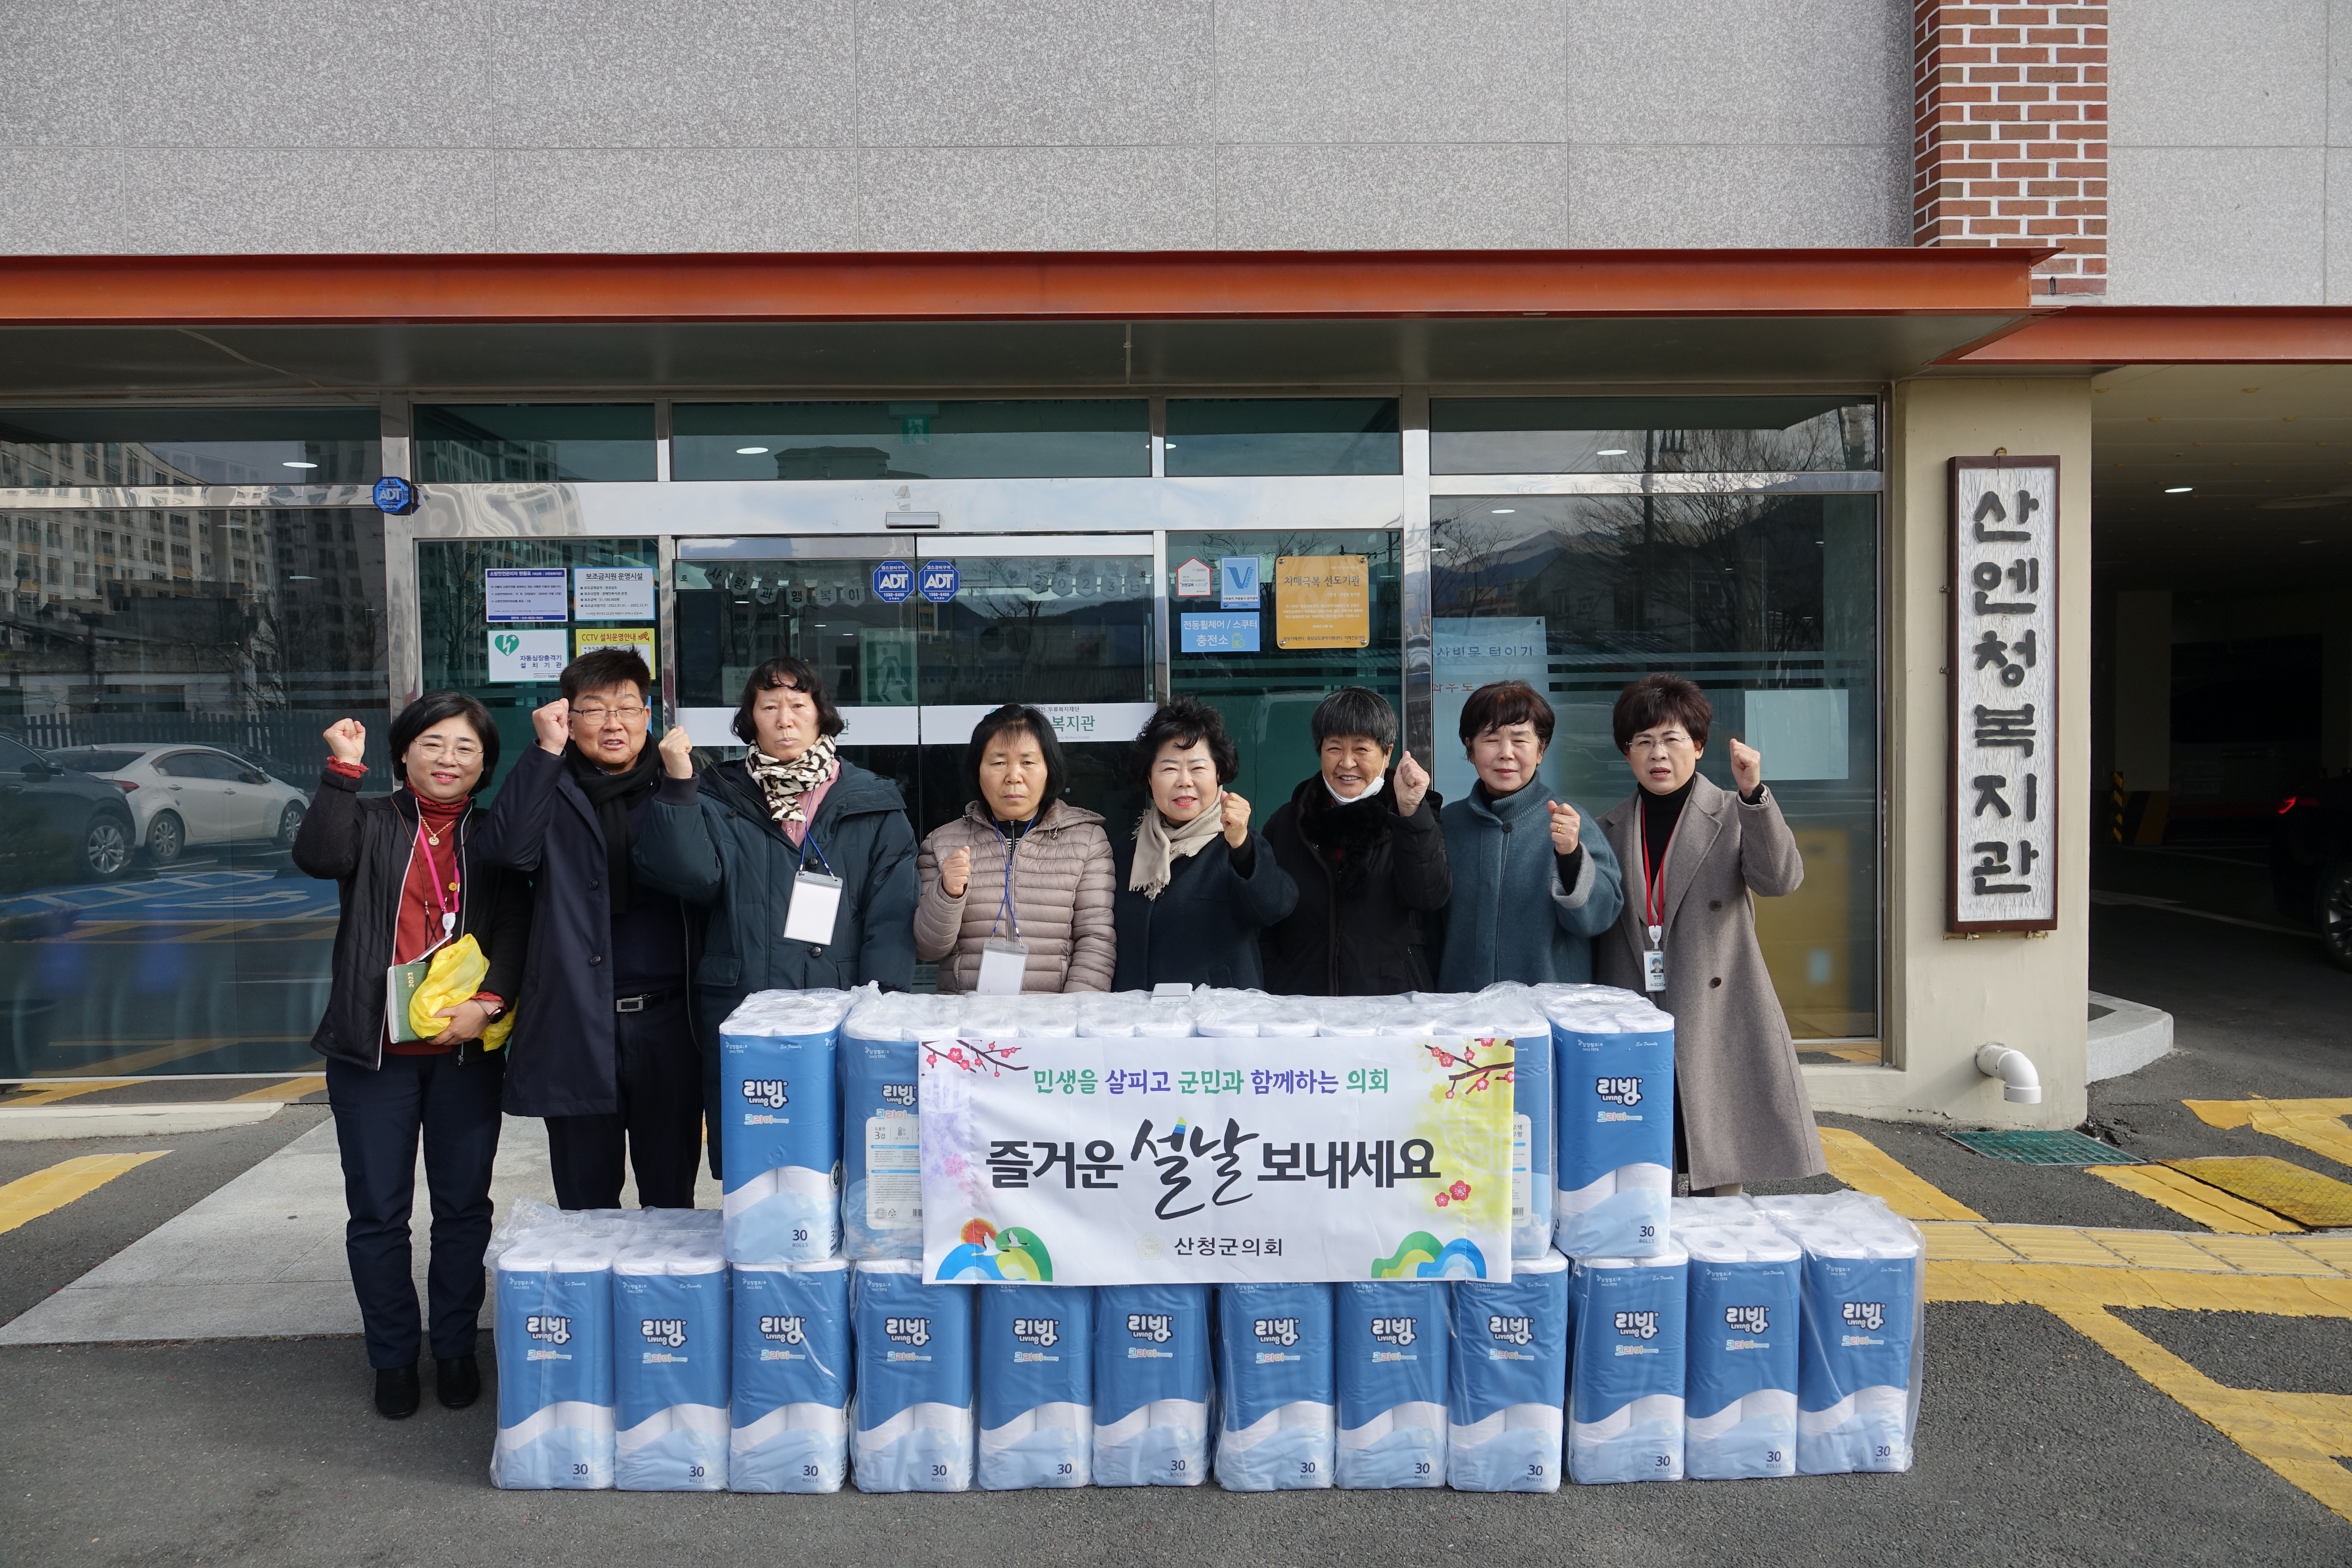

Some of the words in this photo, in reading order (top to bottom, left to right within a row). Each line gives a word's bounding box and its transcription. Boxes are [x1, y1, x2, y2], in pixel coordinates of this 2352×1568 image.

[379, 488, 402, 500] ADT
[880, 574, 908, 588] ADT
[925, 574, 953, 588] ADT
[1284, 576, 1320, 587] 치매극복
[1324, 575, 1360, 587] 선도기관
[1183, 619, 1224, 631] 전동휠체어
[1233, 619, 1257, 629] 스쿠터
[600, 633, 636, 641] 설치운영안내
[1196, 634, 1229, 647] 충전소
[1973, 490, 2040, 896] 산엔청복지관
[1052, 715, 1096, 732] 복지관
[1034, 1069, 1098, 1094] 민생을
[1105, 1069, 1171, 1094] 살피고
[1178, 1069, 1244, 1095] 군민과
[1250, 1069, 1339, 1095] 함께하는
[1346, 1068, 1388, 1093] 의회
[744, 1081, 787, 1108] 리빙
[883, 1085, 917, 1106] 리빙
[1598, 1078, 1642, 1105] 리빙
[875, 1131, 885, 1139] 3겹
[986, 1140, 1124, 1188] 즐거운
[1130, 1117, 1260, 1220] 설날
[1257, 1139, 1441, 1189] 보내세요
[792, 1229, 808, 1241] 30
[1639, 1225, 1654, 1237] 30
[1174, 1237, 1282, 1256] 산청군의회
[1726, 1307, 1769, 1333] 리빙
[1843, 1303, 1885, 1329] 리빙
[527, 1317, 570, 1344] 리빙
[761, 1317, 805, 1344] 리빙
[886, 1319, 929, 1345] 리빙
[1128, 1315, 1172, 1342] 리빙
[1255, 1319, 1299, 1345] 리빙
[1372, 1319, 1416, 1345] 리빙
[1490, 1317, 1534, 1344] 리빙
[1616, 1312, 1659, 1338] 리빙
[642, 1320, 686, 1347] 리빙
[1014, 1320, 1059, 1346] 리빙
[1766, 1451, 1781, 1462] 30
[1875, 1446, 1890, 1457] 30
[1170, 1460, 1185, 1471] 30
[1300, 1462, 1315, 1473] 30
[1415, 1463, 1430, 1474] 30
[1655, 1456, 1670, 1467] 30
[573, 1464, 588, 1475] 30
[689, 1466, 704, 1477] 30
[803, 1465, 818, 1476] 30
[931, 1465, 947, 1476] 30
[1057, 1463, 1072, 1475] 30
[1527, 1464, 1543, 1476] 30
